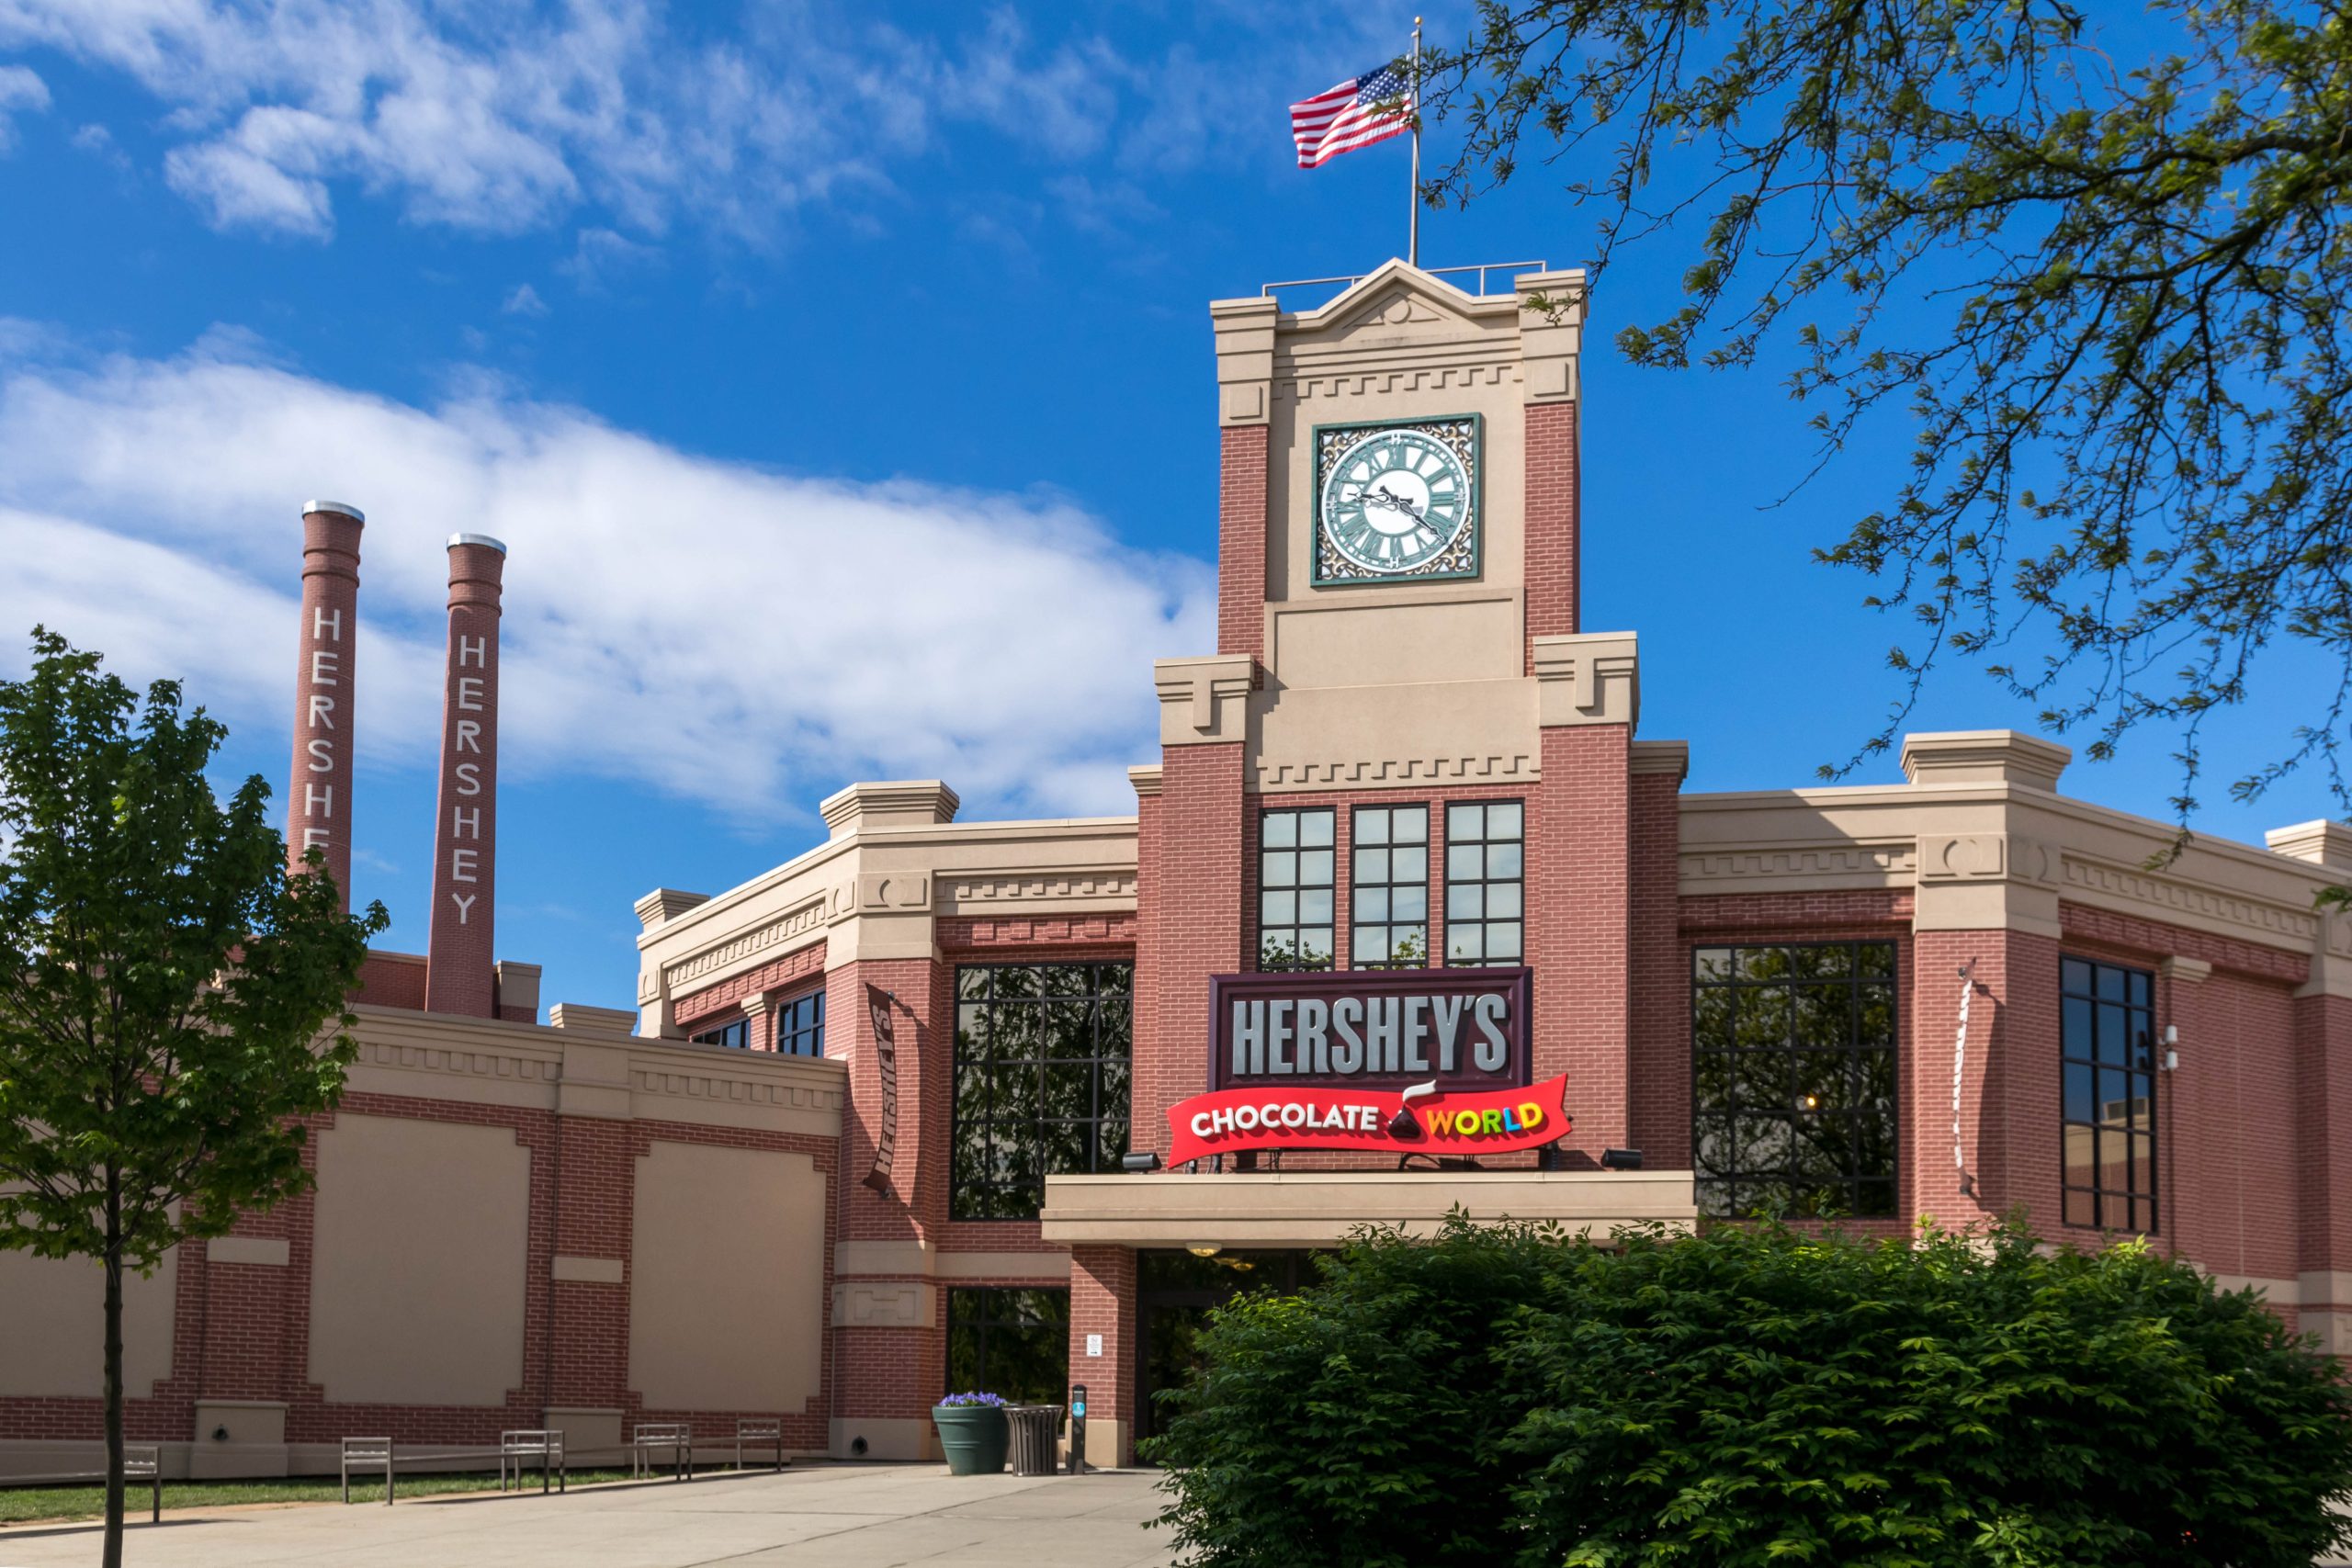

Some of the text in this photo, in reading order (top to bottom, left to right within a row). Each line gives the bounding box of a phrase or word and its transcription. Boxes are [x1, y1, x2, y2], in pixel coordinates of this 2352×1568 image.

[304, 606, 341, 895] HERSHE
[451, 634, 486, 925] HERSHEY
[872, 1004, 897, 1176] HERSHEY'S
[1191, 1101, 1544, 1137] CHOCOLATE WORLD
[1232, 993, 1507, 1075] HERSHEY'S
